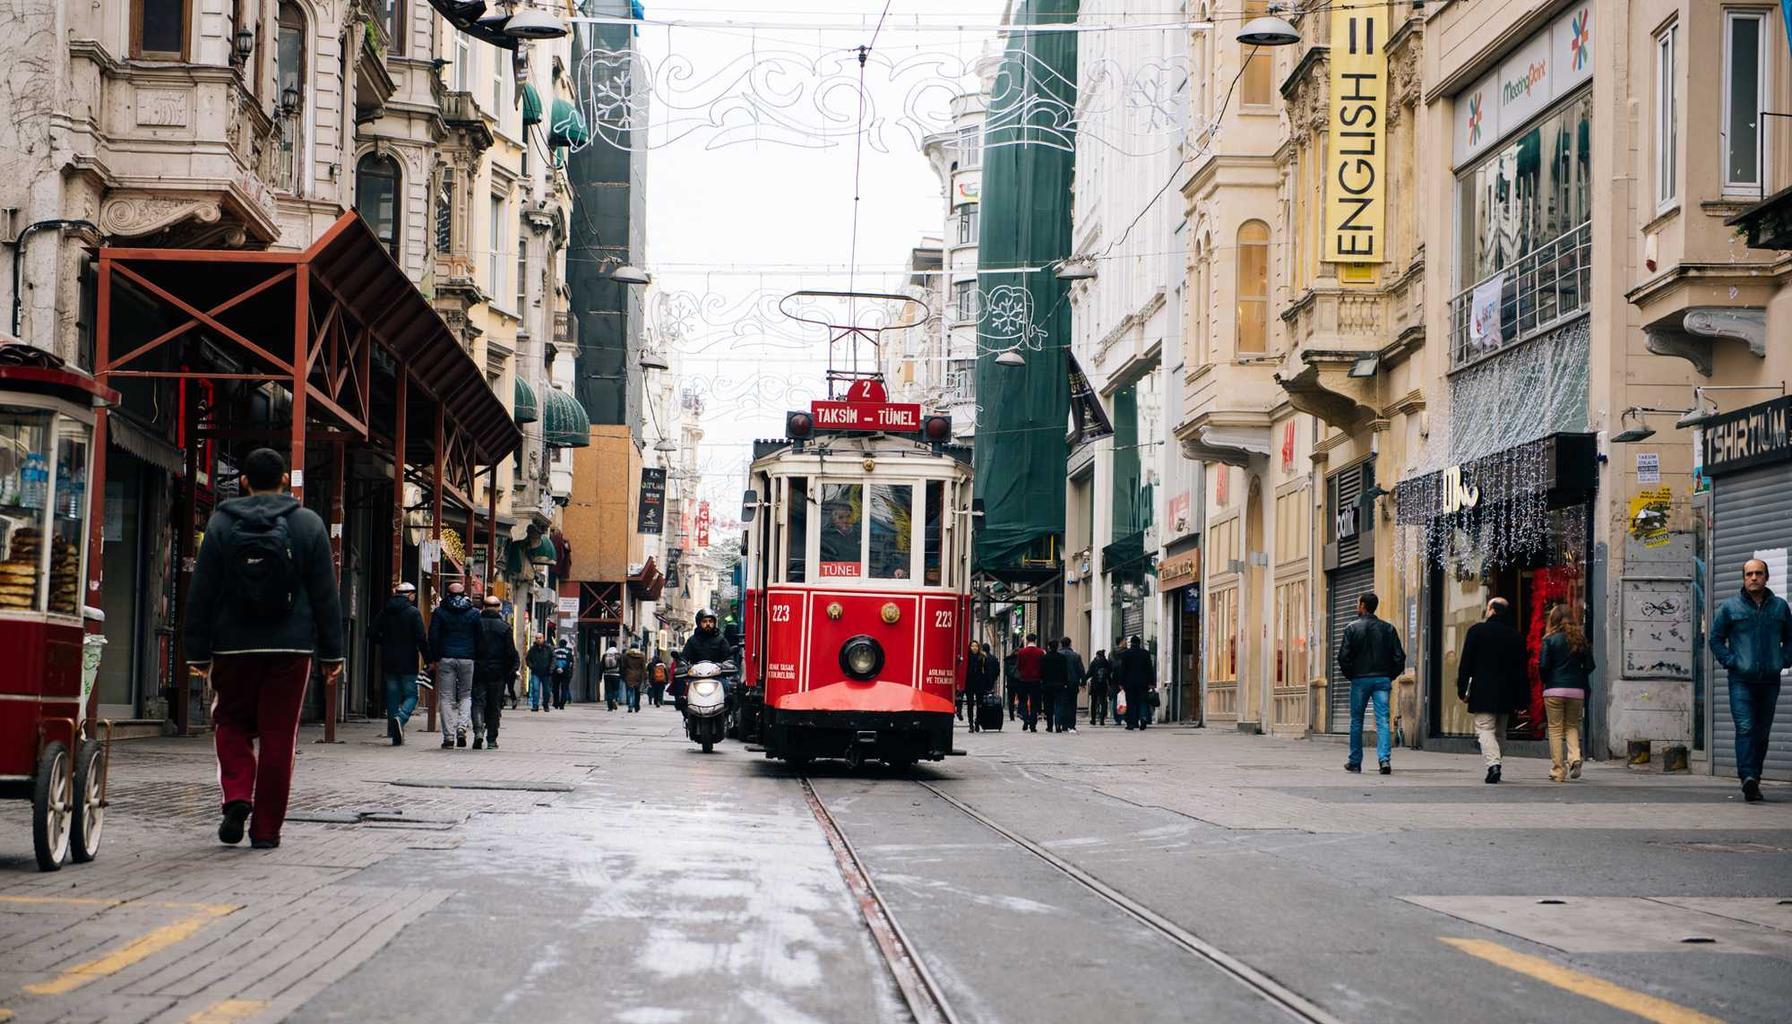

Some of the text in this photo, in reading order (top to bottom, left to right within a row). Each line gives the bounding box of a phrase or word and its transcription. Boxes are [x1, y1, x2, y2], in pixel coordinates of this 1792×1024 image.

[1337, 73, 1377, 256] ENGLISH
[862, 381, 871, 398] 2
[878, 407, 916, 426] TÜNEL
[822, 563, 859, 576] TÜNEL
[772, 604, 790, 622] 223
[935, 610, 952, 628] 223
